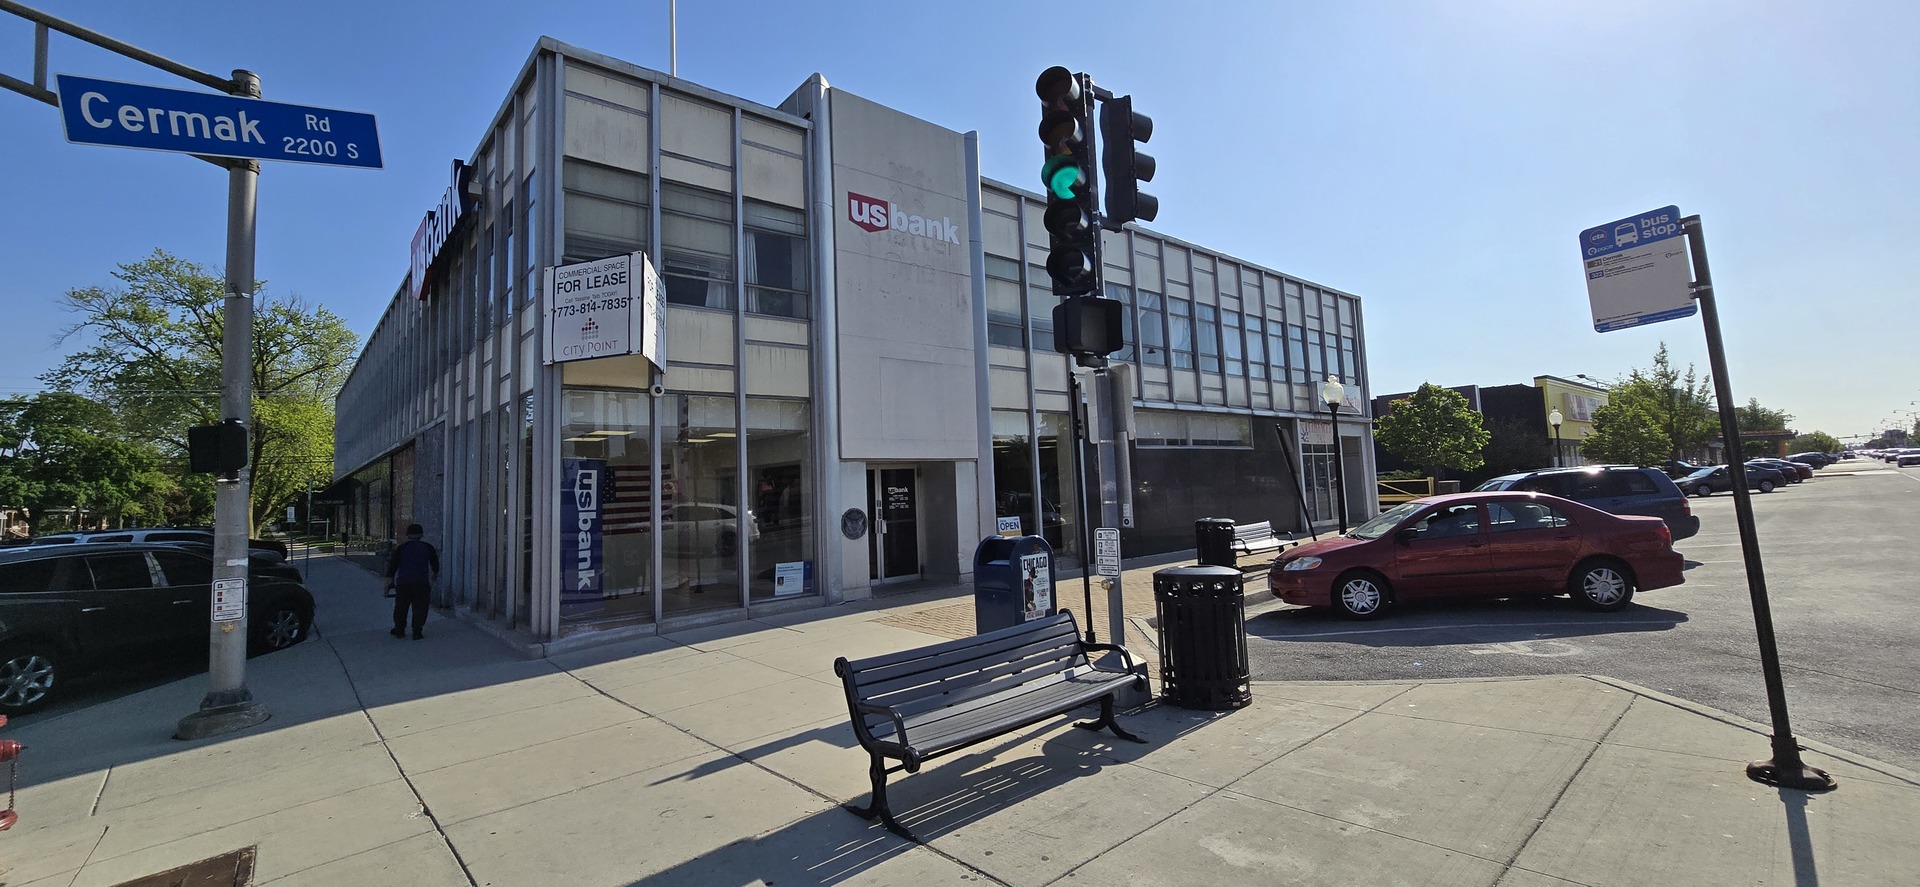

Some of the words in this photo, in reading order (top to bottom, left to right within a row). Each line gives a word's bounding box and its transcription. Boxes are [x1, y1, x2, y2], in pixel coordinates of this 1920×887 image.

[80, 91, 266, 145] Cermak
[304, 114, 331, 133] Rd
[282, 136, 338, 158] 2200
[346, 143, 359, 159] S
[1640, 214, 1670, 229] bus
[1591, 232, 1605, 242] cta
[1642, 223, 1677, 239] stop
[1602, 253, 1624, 262] Cermak
[558, 265, 602, 280] COMMERCIAL
[603, 261, 626, 271] SPACE
[556, 279, 581, 295] FOR
[586, 271, 627, 290] LEASE
[557, 297, 627, 318] 773-814-7835
[587, 339, 618, 353] POINT
[1000, 521, 1020, 531] OPEN
[1023, 556, 1048, 571] CHICAGO
